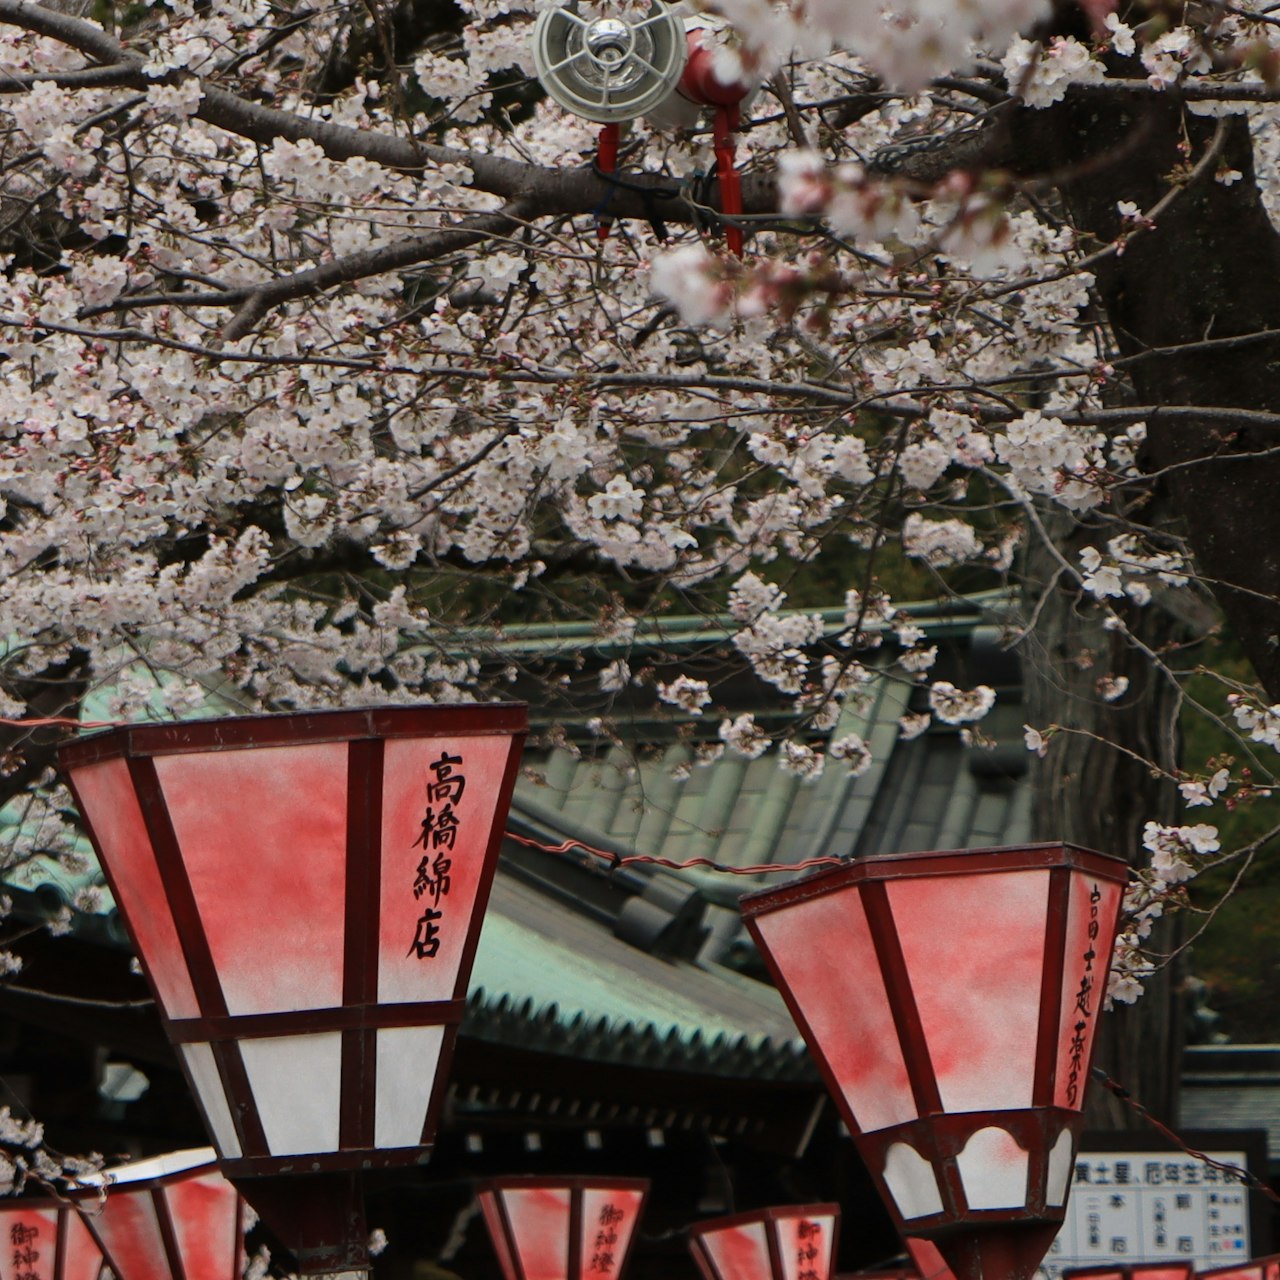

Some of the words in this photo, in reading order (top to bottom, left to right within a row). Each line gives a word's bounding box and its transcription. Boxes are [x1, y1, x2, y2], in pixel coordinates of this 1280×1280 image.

[406, 751, 466, 960] 高橋綿店
[10, 1221, 41, 1280] 御神
